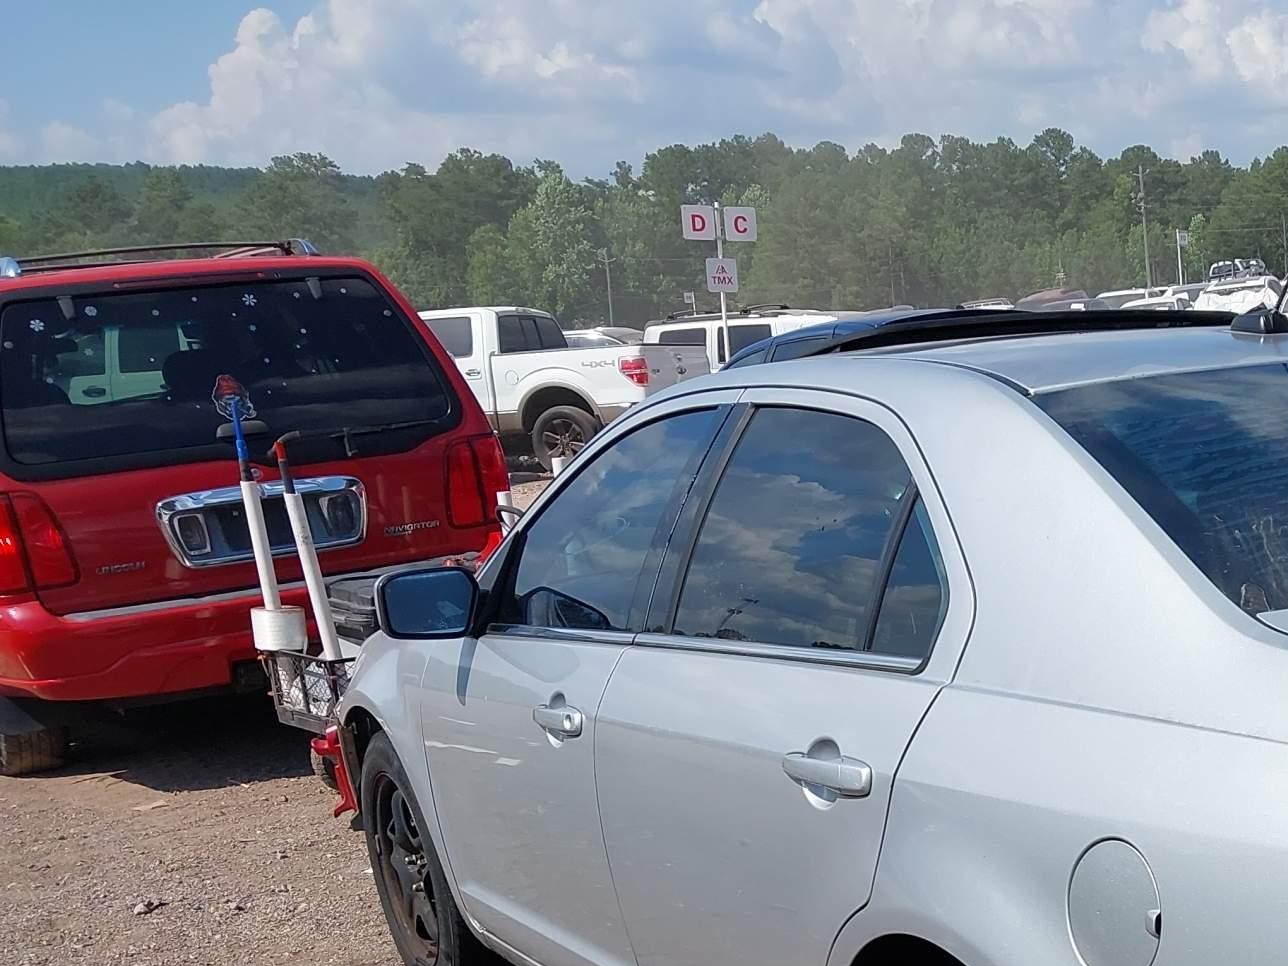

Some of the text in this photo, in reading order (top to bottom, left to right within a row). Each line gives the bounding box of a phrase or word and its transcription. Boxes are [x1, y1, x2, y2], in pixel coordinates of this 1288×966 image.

[691, 214, 706, 232] D
[734, 216, 748, 234] C
[711, 276, 734, 285] TMX
[384, 520, 440, 534] NAVIGATOR
